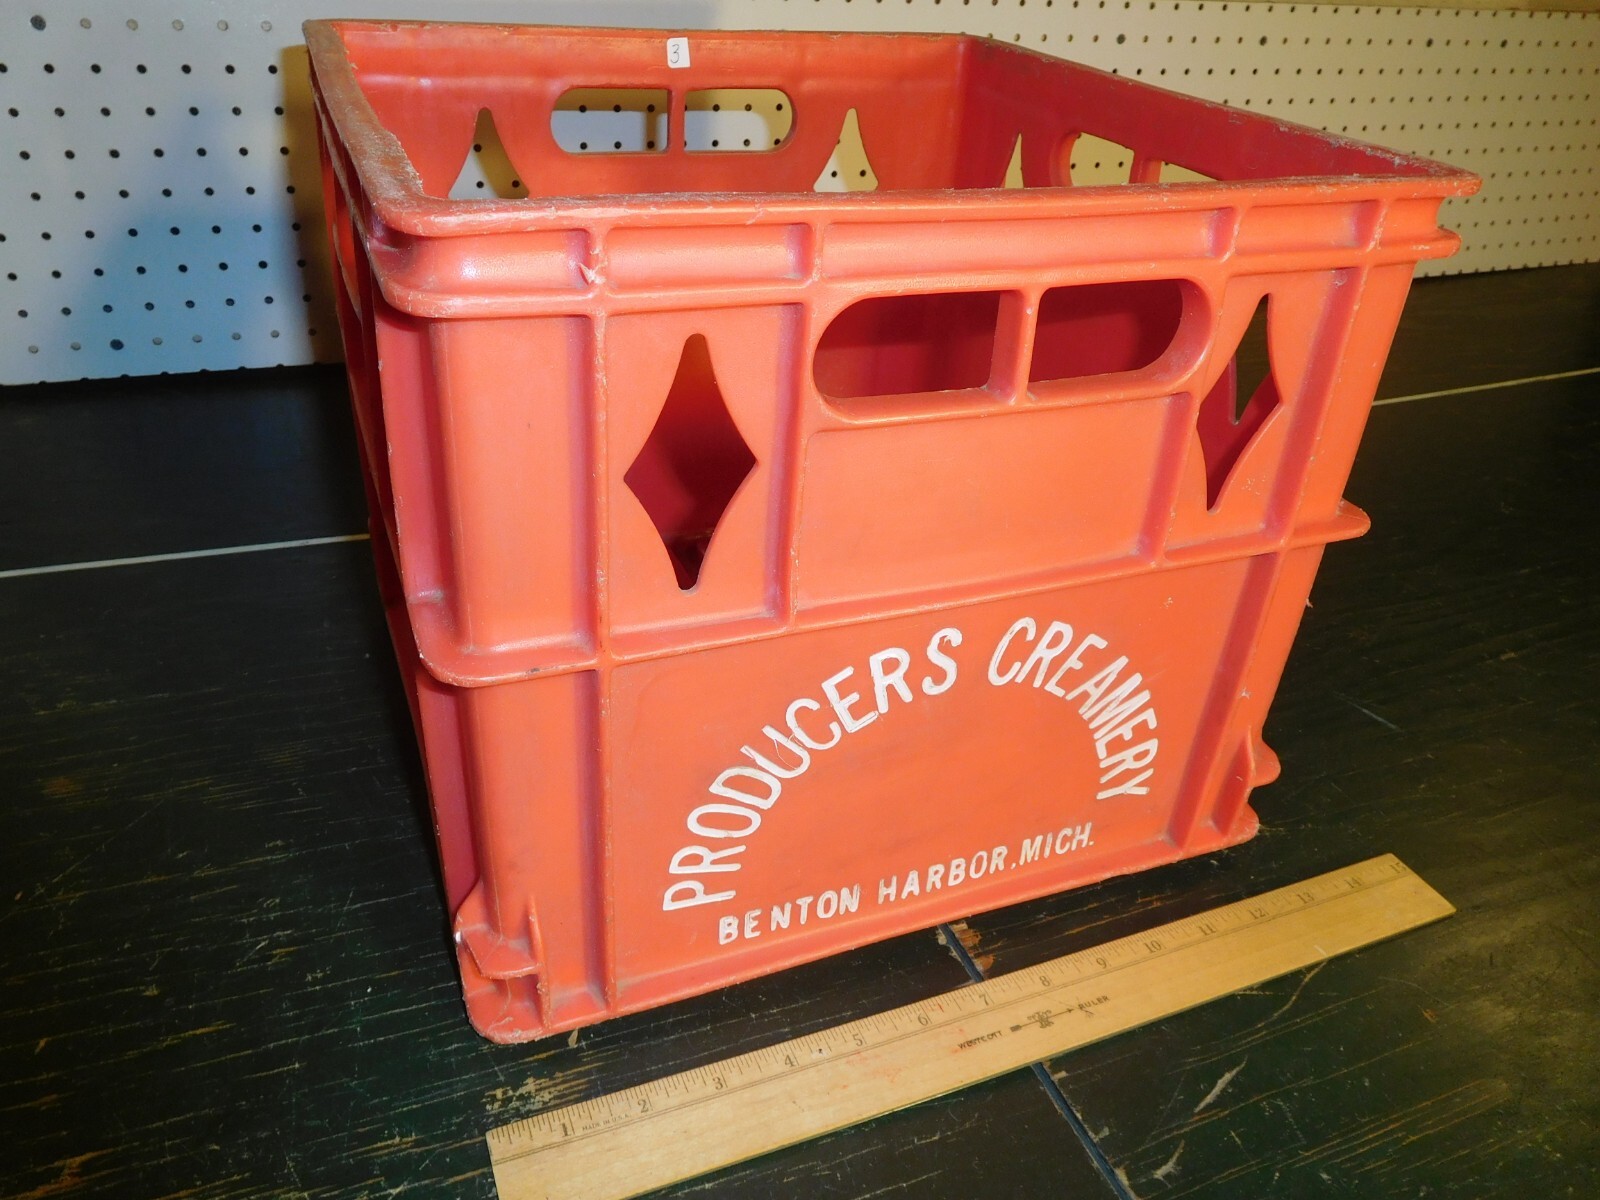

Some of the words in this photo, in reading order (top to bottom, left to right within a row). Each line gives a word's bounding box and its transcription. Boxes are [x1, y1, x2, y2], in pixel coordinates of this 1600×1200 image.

[670, 43, 680, 64] 3
[662, 627, 963, 911] PRODUCERS
[987, 617, 1160, 800] CREAMERY
[718, 883, 861, 945] BENTON
[562, 1122, 572, 1137] 1
[637, 1099, 650, 1113] 2
[712, 1076, 724, 1091] 3
[783, 1054, 796, 1068] 4
[852, 1033, 863, 1046] 5
[917, 1013, 929, 1027] 6
[978, 994, 990, 1006] 7
[1039, 975, 1050, 988] 8
[1096, 957, 1107, 969] 9
[1144, 940, 1162, 954] 10
[1199, 924, 1217, 936] 11
[1249, 907, 1267, 920] 12
[1296, 892, 1315, 904] 13
[1344, 877, 1362, 889] 14
[958, 1030, 1003, 1050] WESTCOTT
[1078, 994, 1110, 1010] RULER
